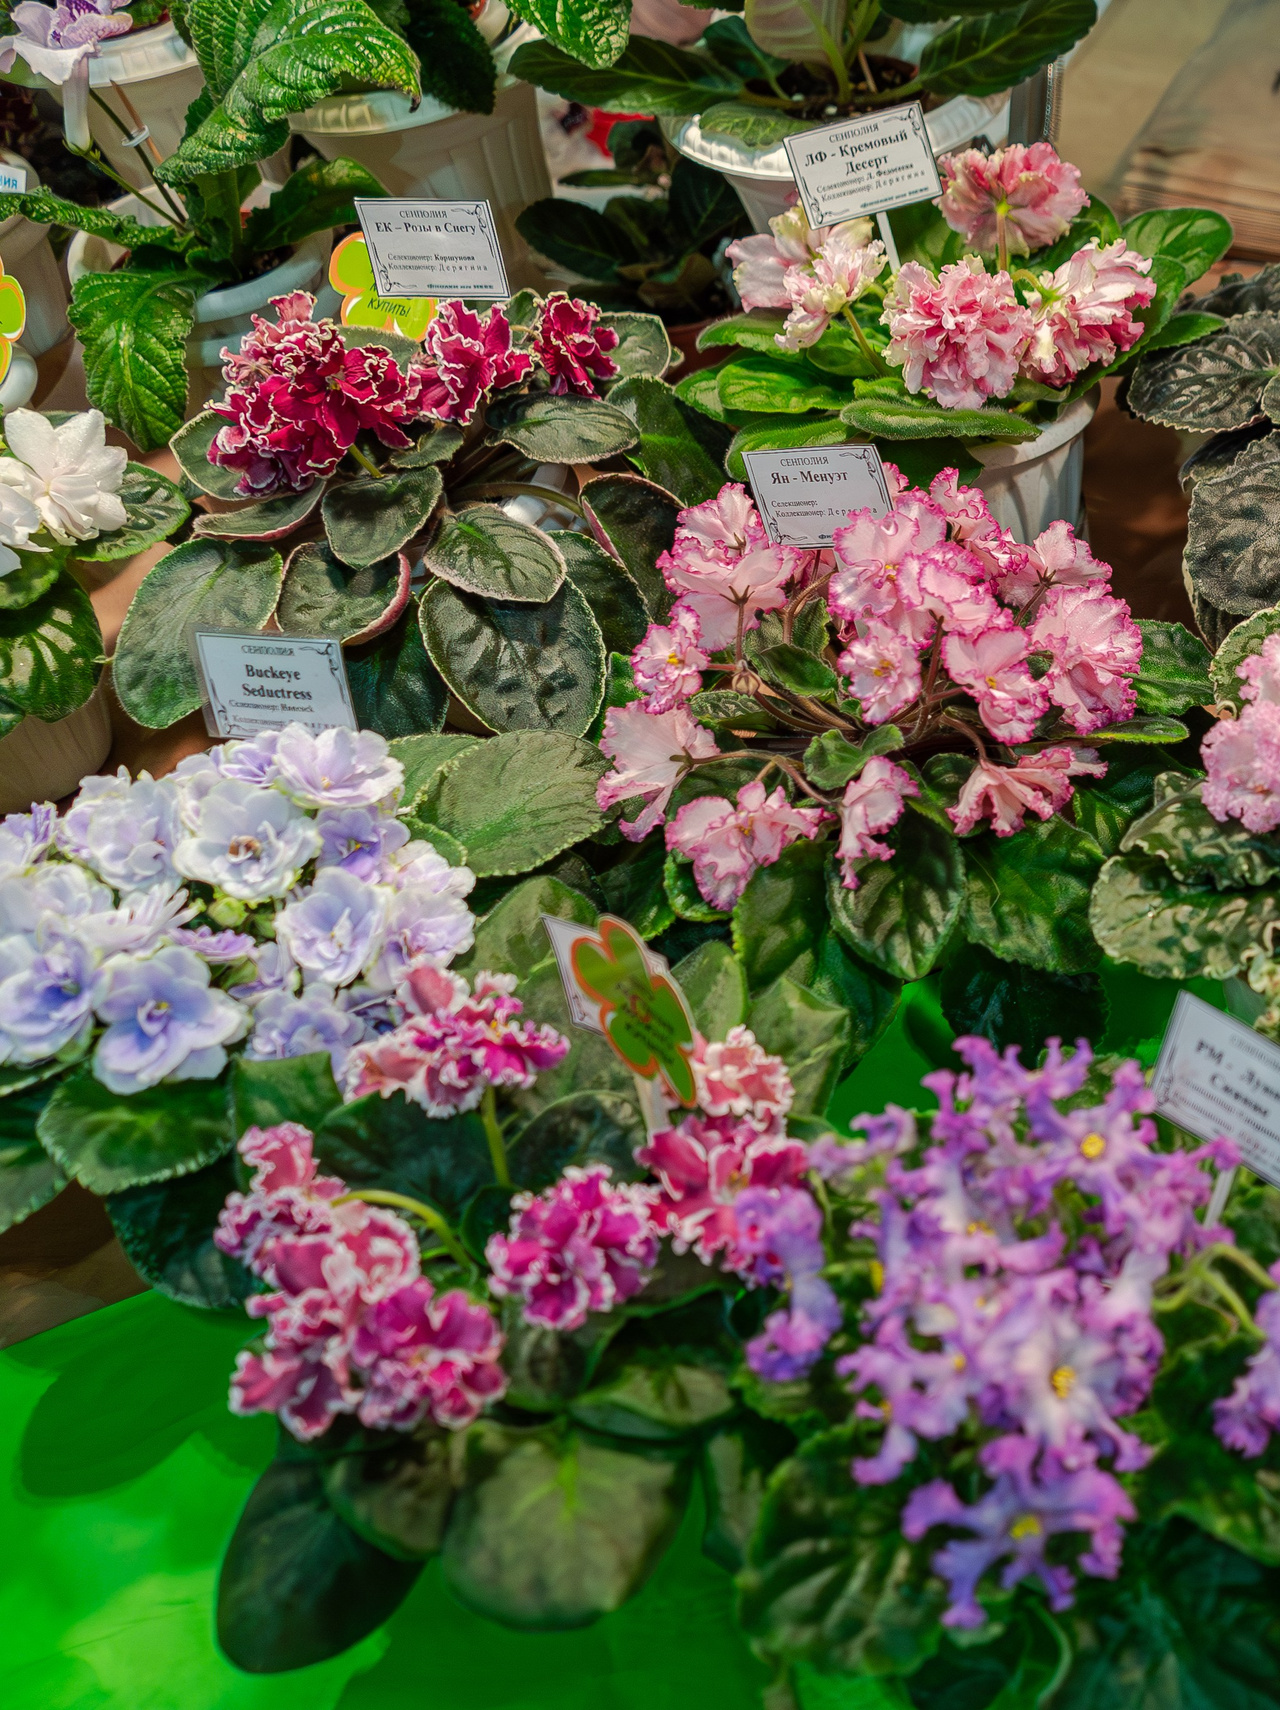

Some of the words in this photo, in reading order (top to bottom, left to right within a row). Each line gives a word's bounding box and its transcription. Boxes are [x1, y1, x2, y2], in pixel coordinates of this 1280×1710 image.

[828, 123, 880, 144] СЕНПОЛИЯ
[804, 151, 827, 167] ЛФ
[839, 129, 908, 158] Кремовый
[845, 155, 889, 176] Десерт
[399, 210, 448, 219] СЕНПОЛИЯ
[375, 222, 392, 233] ЕК
[405, 222, 431, 233] Розы
[436, 224, 441, 233] в
[444, 222, 476, 235] Снегу
[367, 298, 410, 317] КУПИТЬ!
[780, 456, 829, 467] СЕНПОЛИЯ
[771, 472, 790, 485] Ян
[800, 470, 848, 485] Менуэт
[771, 500, 818, 508] Селекционер:
[775, 510, 825, 518] Коллекционер:
[245, 664, 301, 682] Buckeye
[242, 683, 312, 700] Seductress
